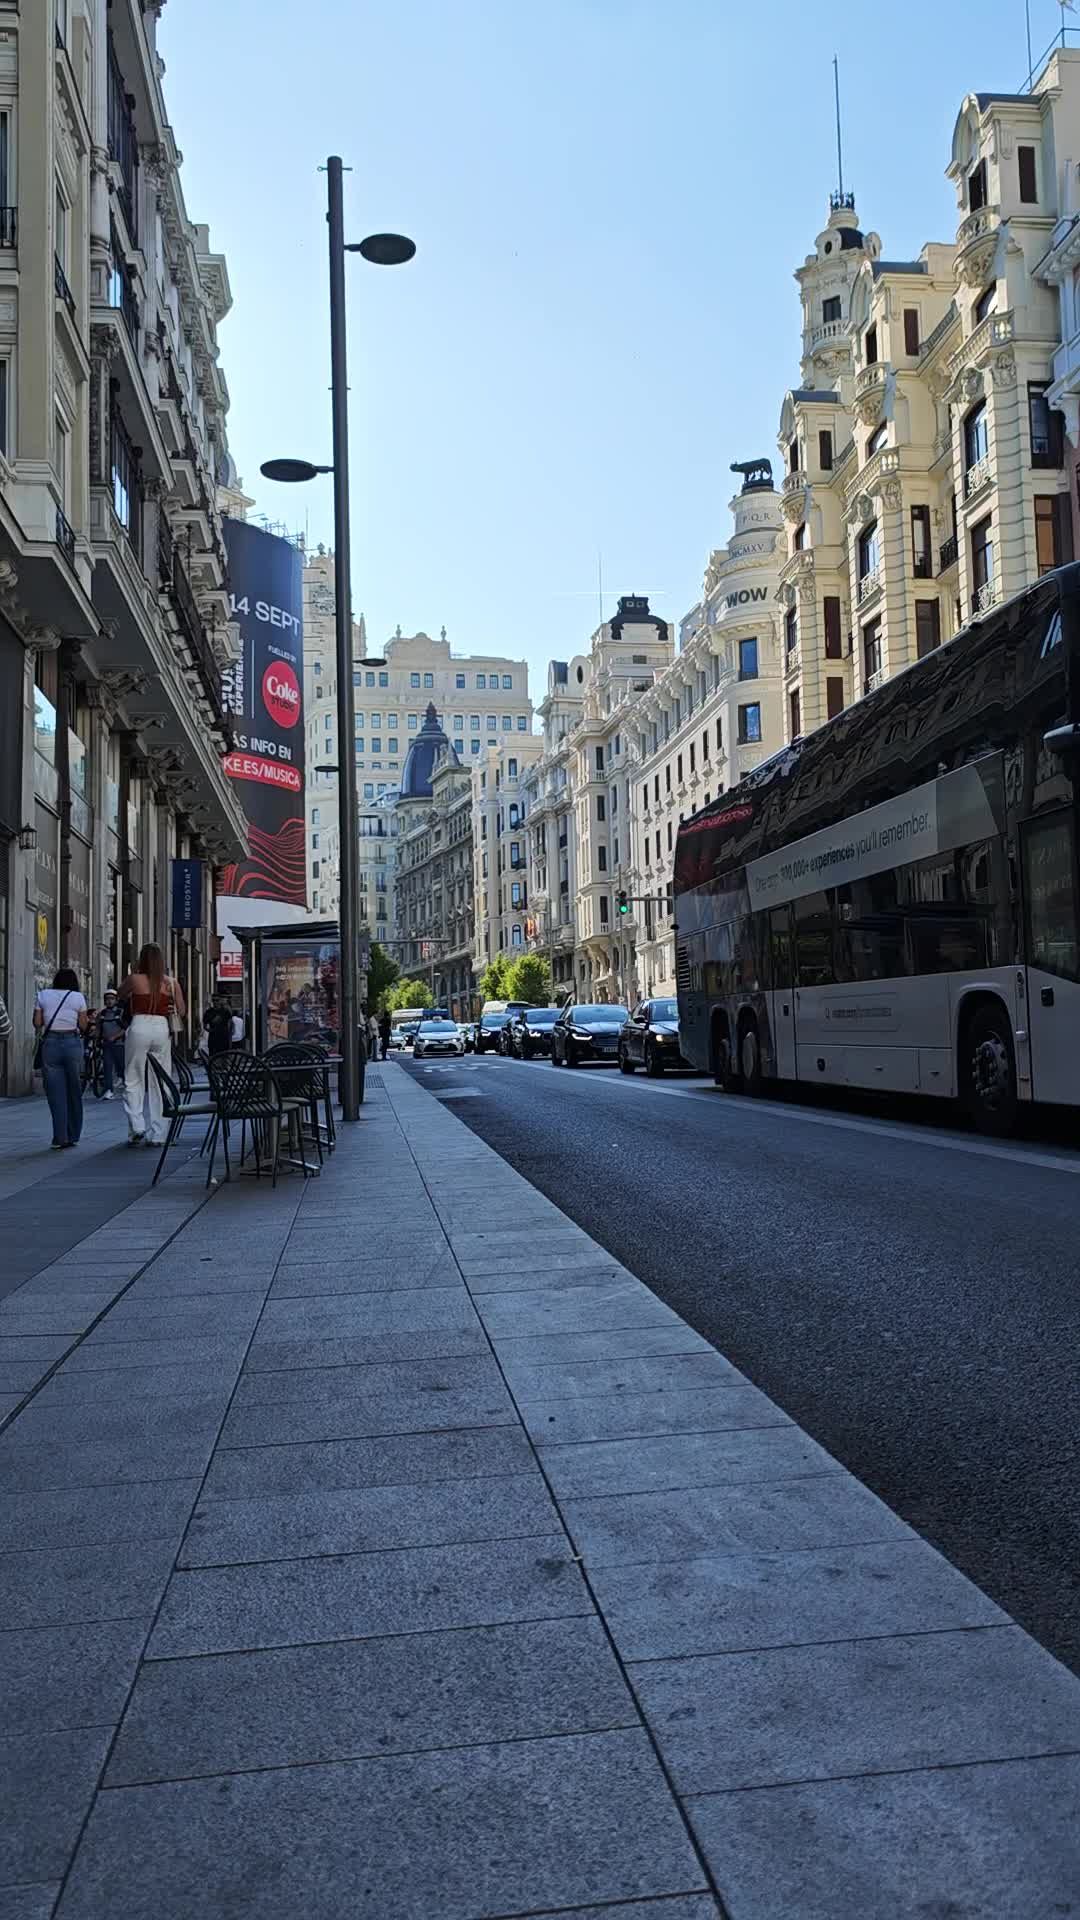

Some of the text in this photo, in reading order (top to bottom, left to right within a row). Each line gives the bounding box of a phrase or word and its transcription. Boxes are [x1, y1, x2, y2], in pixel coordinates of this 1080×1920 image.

[726, 587, 768, 608] WOW
[229, 593, 301, 636] 14 SEPT
[266, 676, 298, 705] Coke
[232, 730, 292, 760] ÁS INFO EN
[223, 756, 301, 788] KE.ES/MUSICA
[810, 844, 855, 876] experiences
[855, 831, 878, 860] you'll
[878, 814, 932, 847] remember.
[184, 873, 192, 921] IBEROSTAR
